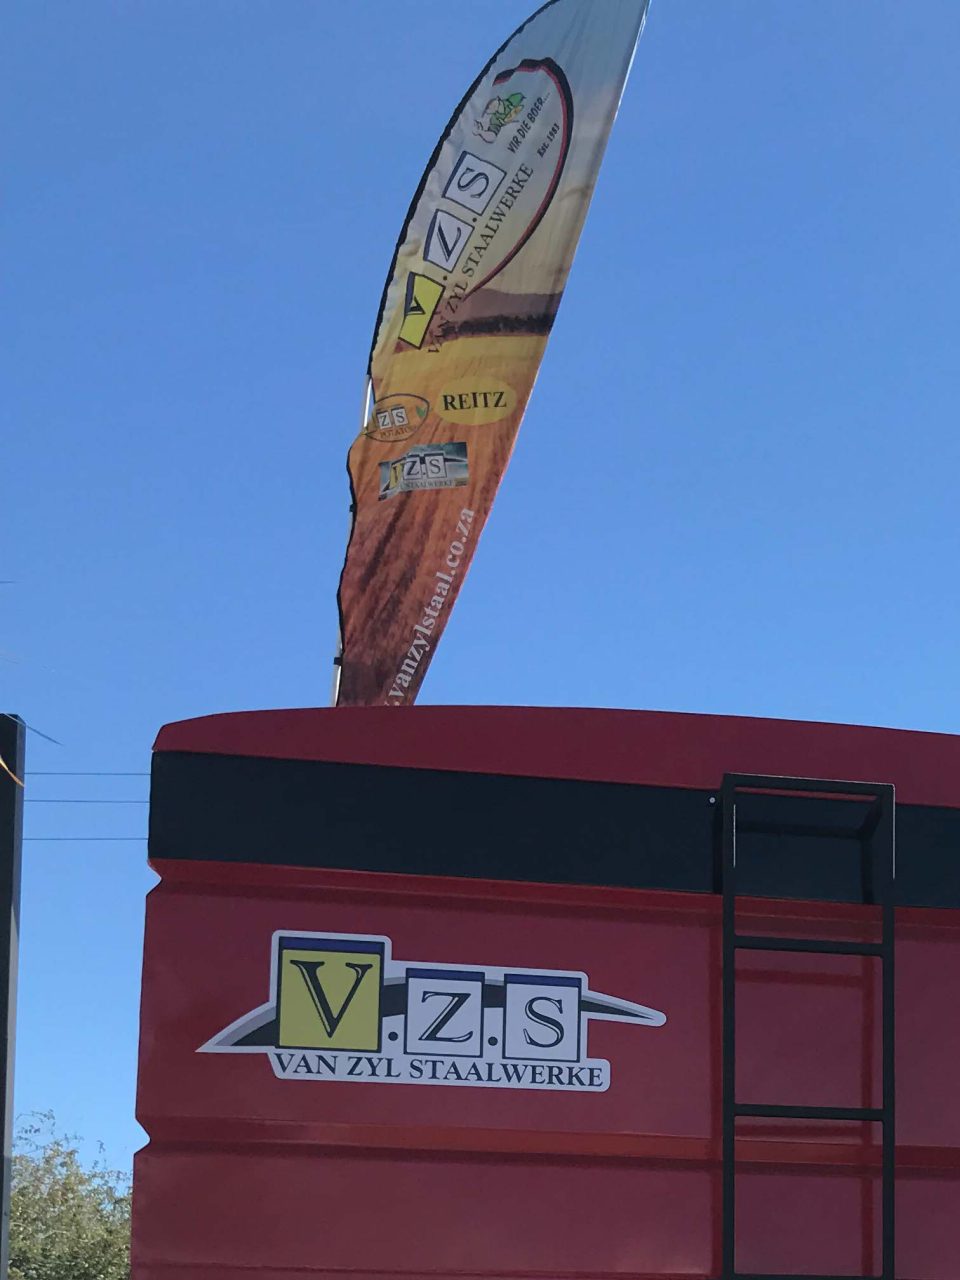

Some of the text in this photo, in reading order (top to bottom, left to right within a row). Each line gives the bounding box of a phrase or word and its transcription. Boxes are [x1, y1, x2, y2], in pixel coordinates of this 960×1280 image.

[507, 133, 523, 154] VIR
[518, 116, 532, 139] DIE
[445, 277, 470, 315] ZYL
[461, 162, 534, 277] STAALWERKE
[442, 390, 507, 411] REITZ
[384, 507, 475, 707] .vanzylstaal.co.za
[290, 959, 566, 1049] V.Z.S
[274, 1052, 605, 1087] VAN ZYL STAALWERKE
